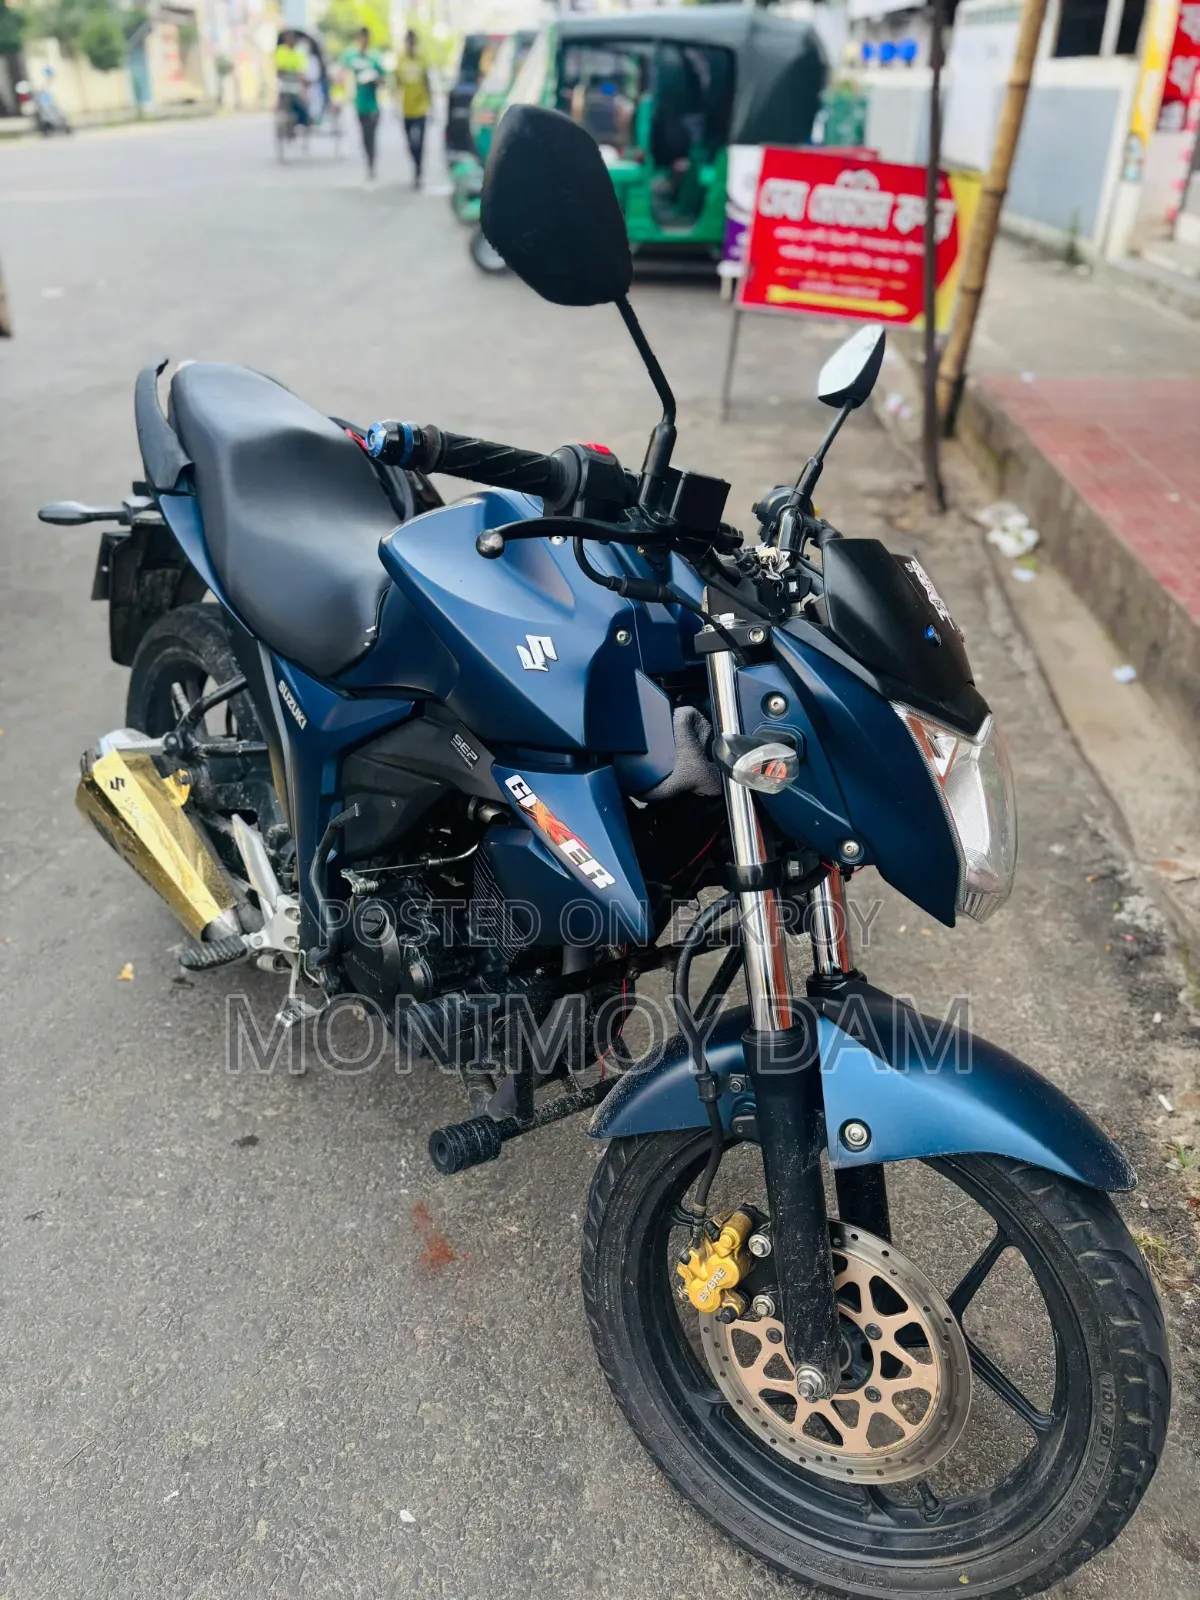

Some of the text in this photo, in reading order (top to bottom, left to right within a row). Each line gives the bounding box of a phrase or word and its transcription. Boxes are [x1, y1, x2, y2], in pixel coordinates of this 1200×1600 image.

[278, 680, 308, 730] SUZUKI
[452, 733, 478, 761] SEP
[504, 774, 617, 890] GIXXER
[699, 1268, 727, 1302] BYBRE
